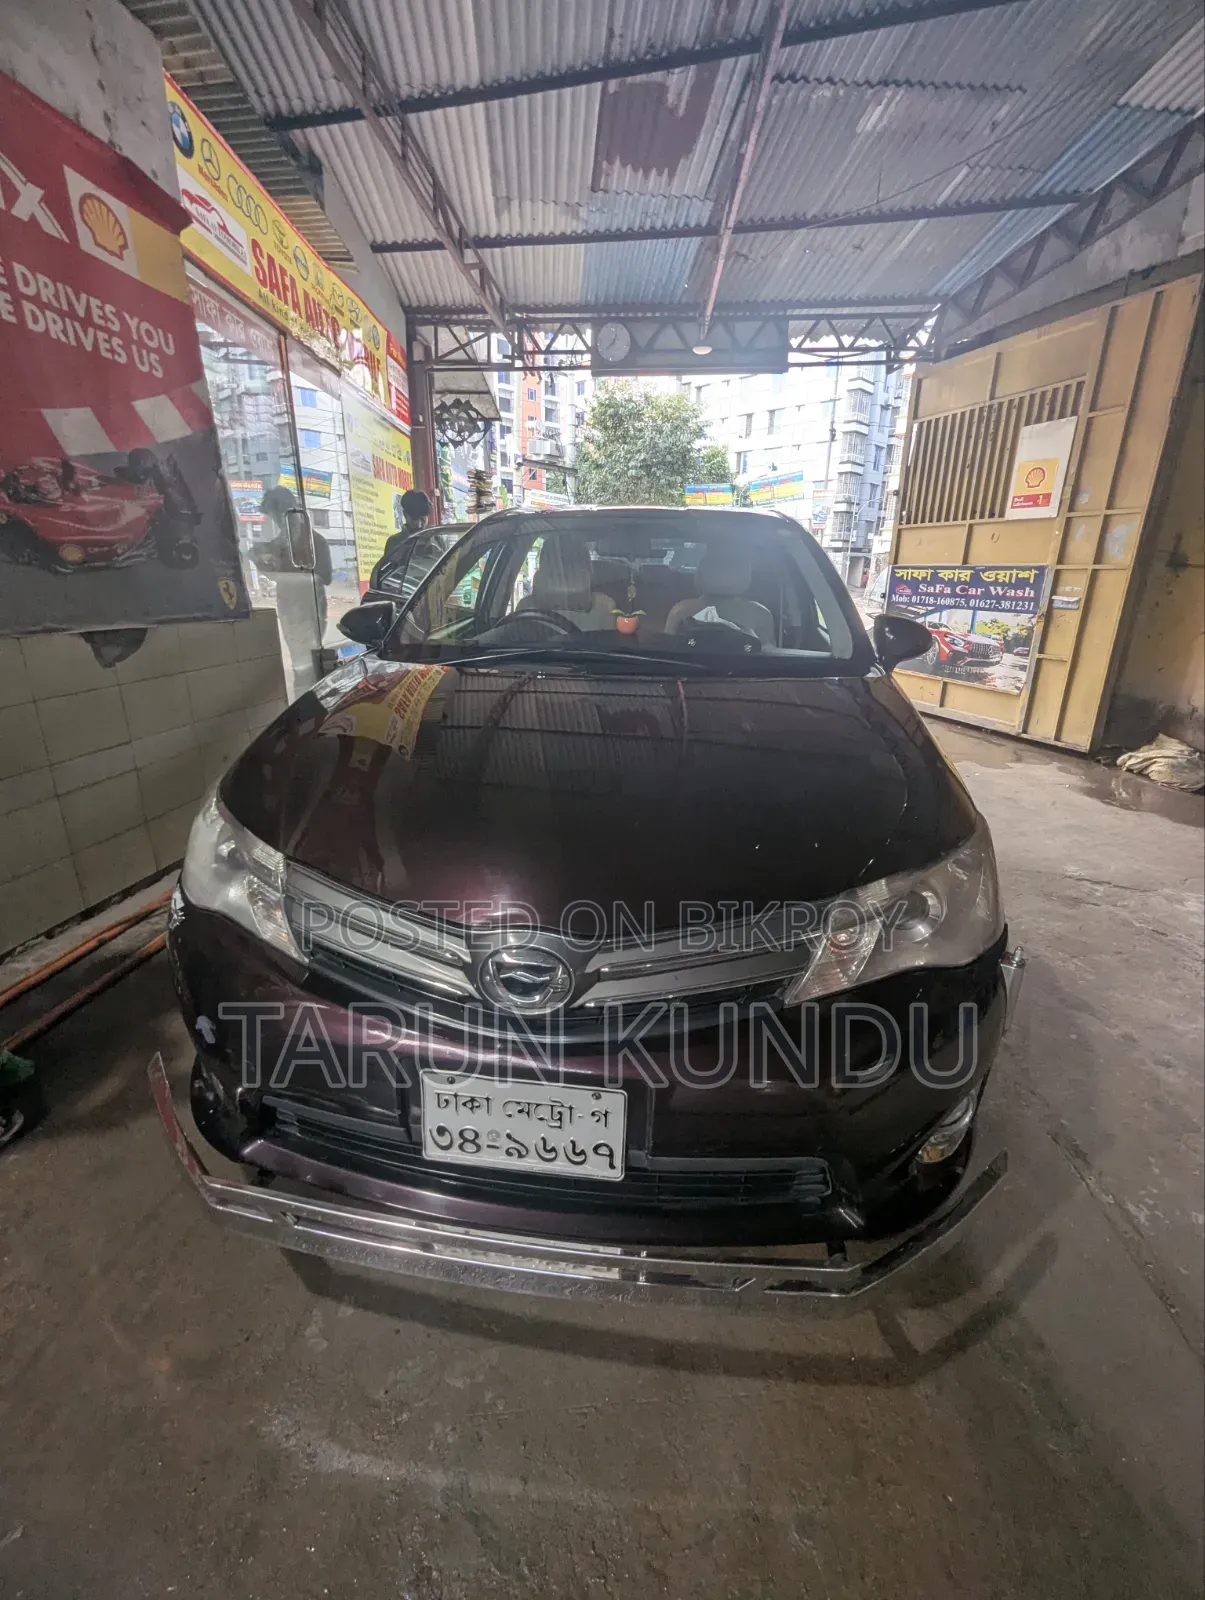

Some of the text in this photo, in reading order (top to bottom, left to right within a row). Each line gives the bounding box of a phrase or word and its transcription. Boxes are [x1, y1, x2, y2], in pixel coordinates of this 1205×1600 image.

[12, 261, 120, 332] DRIVES
[123, 311, 175, 356] YOU
[251, 238, 303, 319] SAFA
[303, 288, 341, 350] AUTO
[22, 299, 127, 364] DRIVES
[132, 345, 163, 379] US
[894, 568, 1040, 584] সাফা কার ওয়াশ
[918, 583, 1035, 597] SaFa Car Wash
[891, 594, 910, 603] Mob:
[969, 598, 1035, 611] 01627-381231
[434, 1091, 492, 1115] ঢাকা
[429, 1124, 617, 1170] ৩৪-৯৬৬৭
